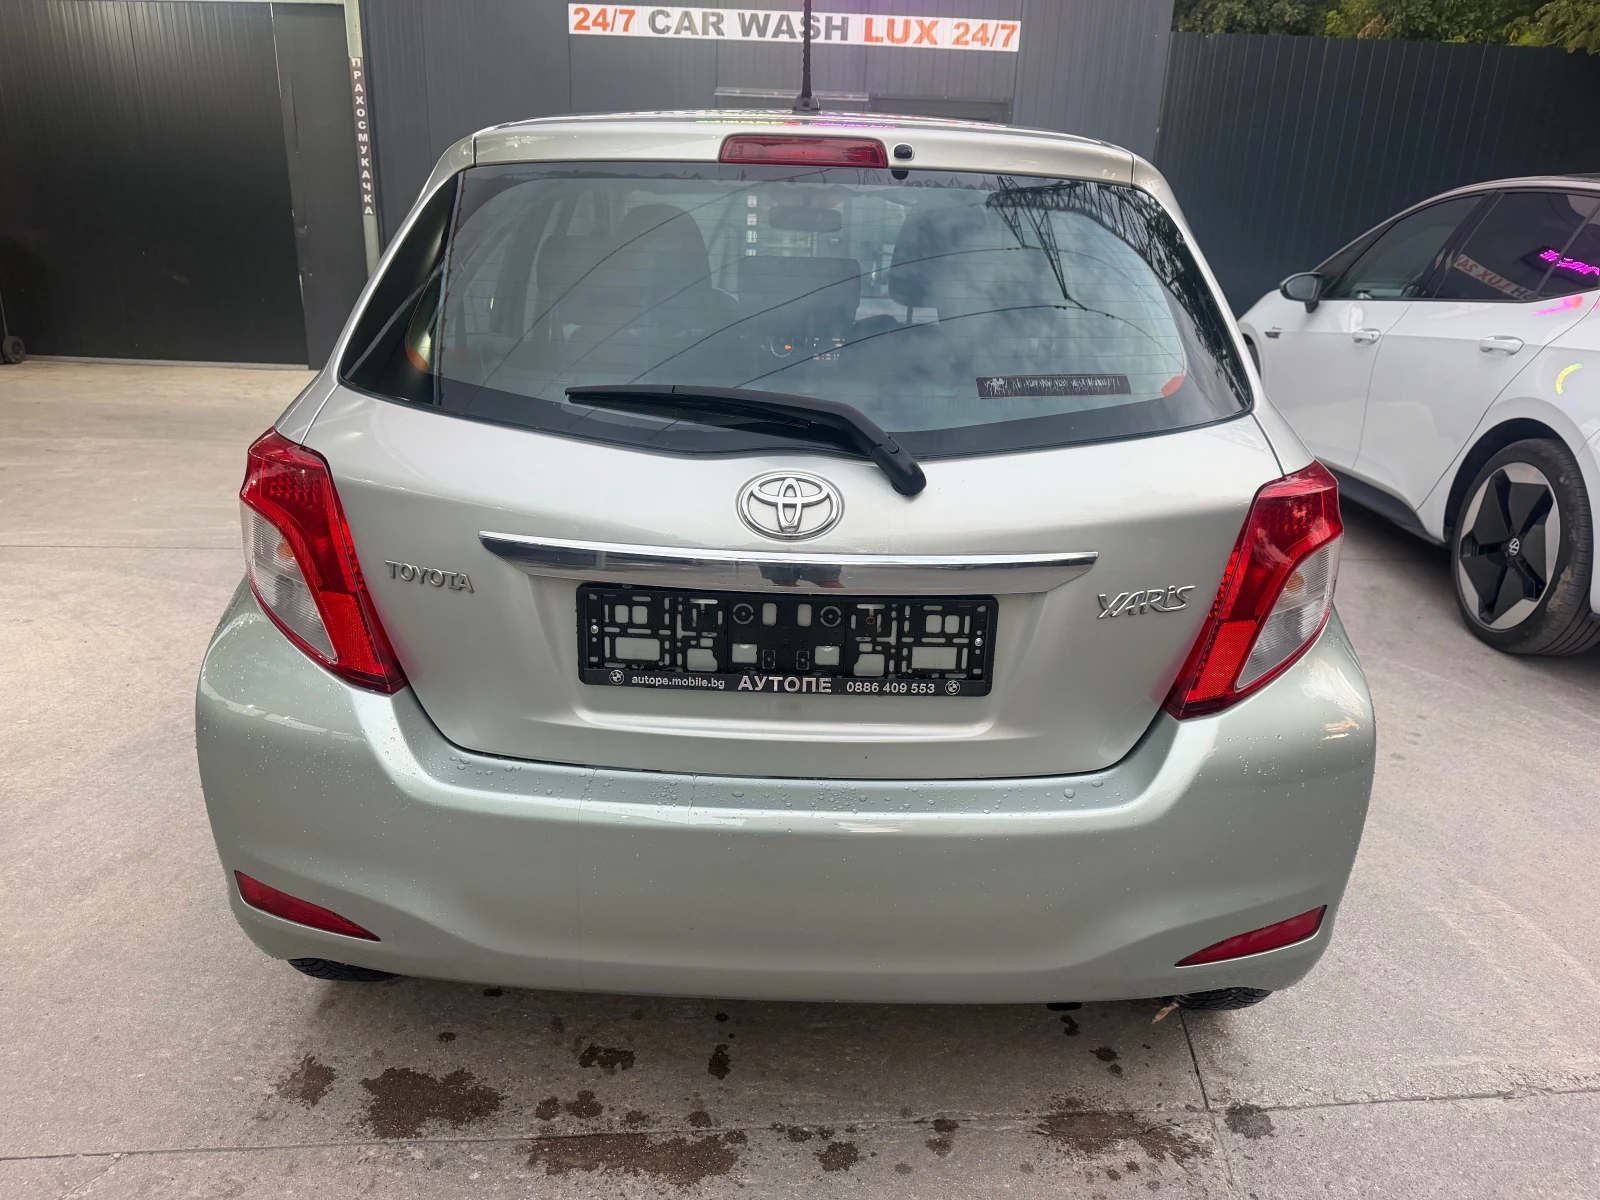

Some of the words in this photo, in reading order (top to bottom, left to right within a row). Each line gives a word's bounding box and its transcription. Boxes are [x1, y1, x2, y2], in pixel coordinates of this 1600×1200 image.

[573, 7, 636, 33] 24/7
[648, 9, 726, 37] CAR
[738, 12, 849, 42] WASH
[864, 17, 939, 46] LUX
[952, 22, 1018, 48] 24/7
[351, 57, 374, 215] ПРАХОСМУКАЧКА
[385, 559, 475, 593] TOYOTA
[631, 675, 725, 690] autope.mobile.bg
[737, 675, 832, 693] АУТОПЕ
[846, 681, 879, 693] 0886
[882, 682, 908, 694] 409
[910, 683, 936, 694] 553
